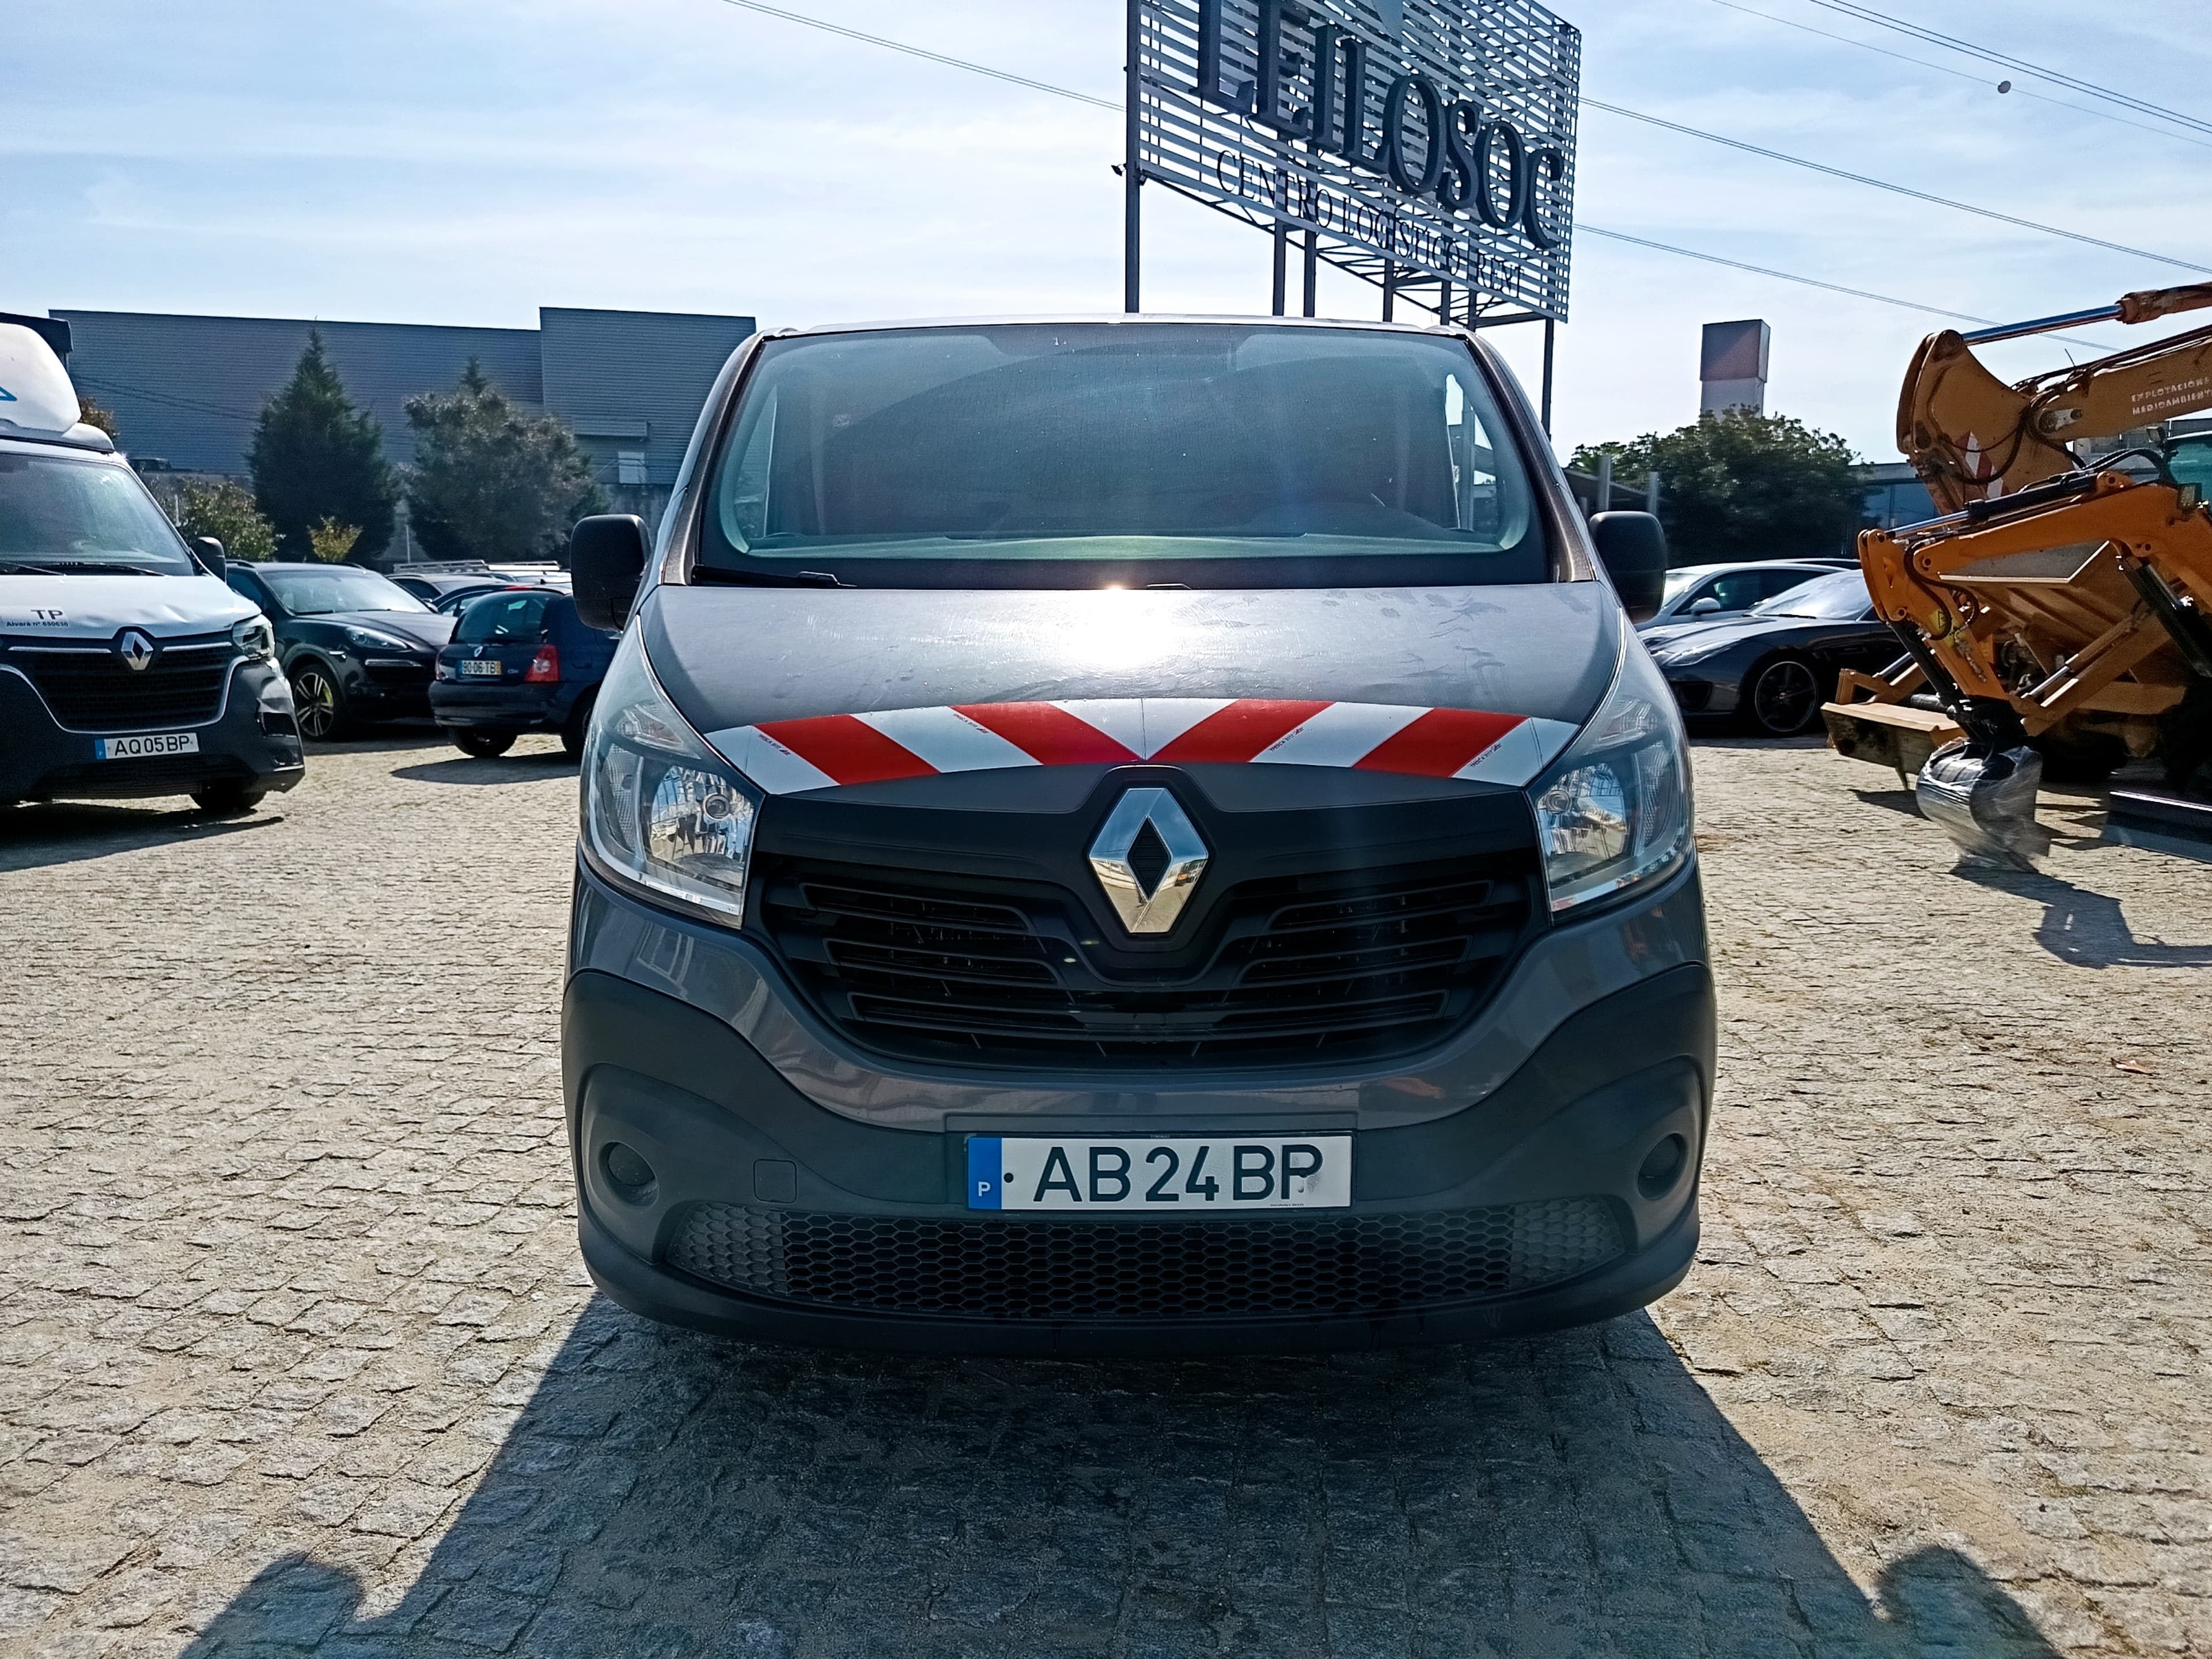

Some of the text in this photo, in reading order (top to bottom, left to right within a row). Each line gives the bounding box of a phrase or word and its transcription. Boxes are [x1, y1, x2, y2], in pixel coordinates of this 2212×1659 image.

[1188, 0, 1563, 249] LEILOSOC
[1217, 150, 1334, 228] CENTRO
[1476, 249, 1524, 298] RENT
[2133, 389, 2212, 415] MEDIOAMBIENT
[31, 609, 63, 620] TP
[978, 1181, 991, 1196] P
